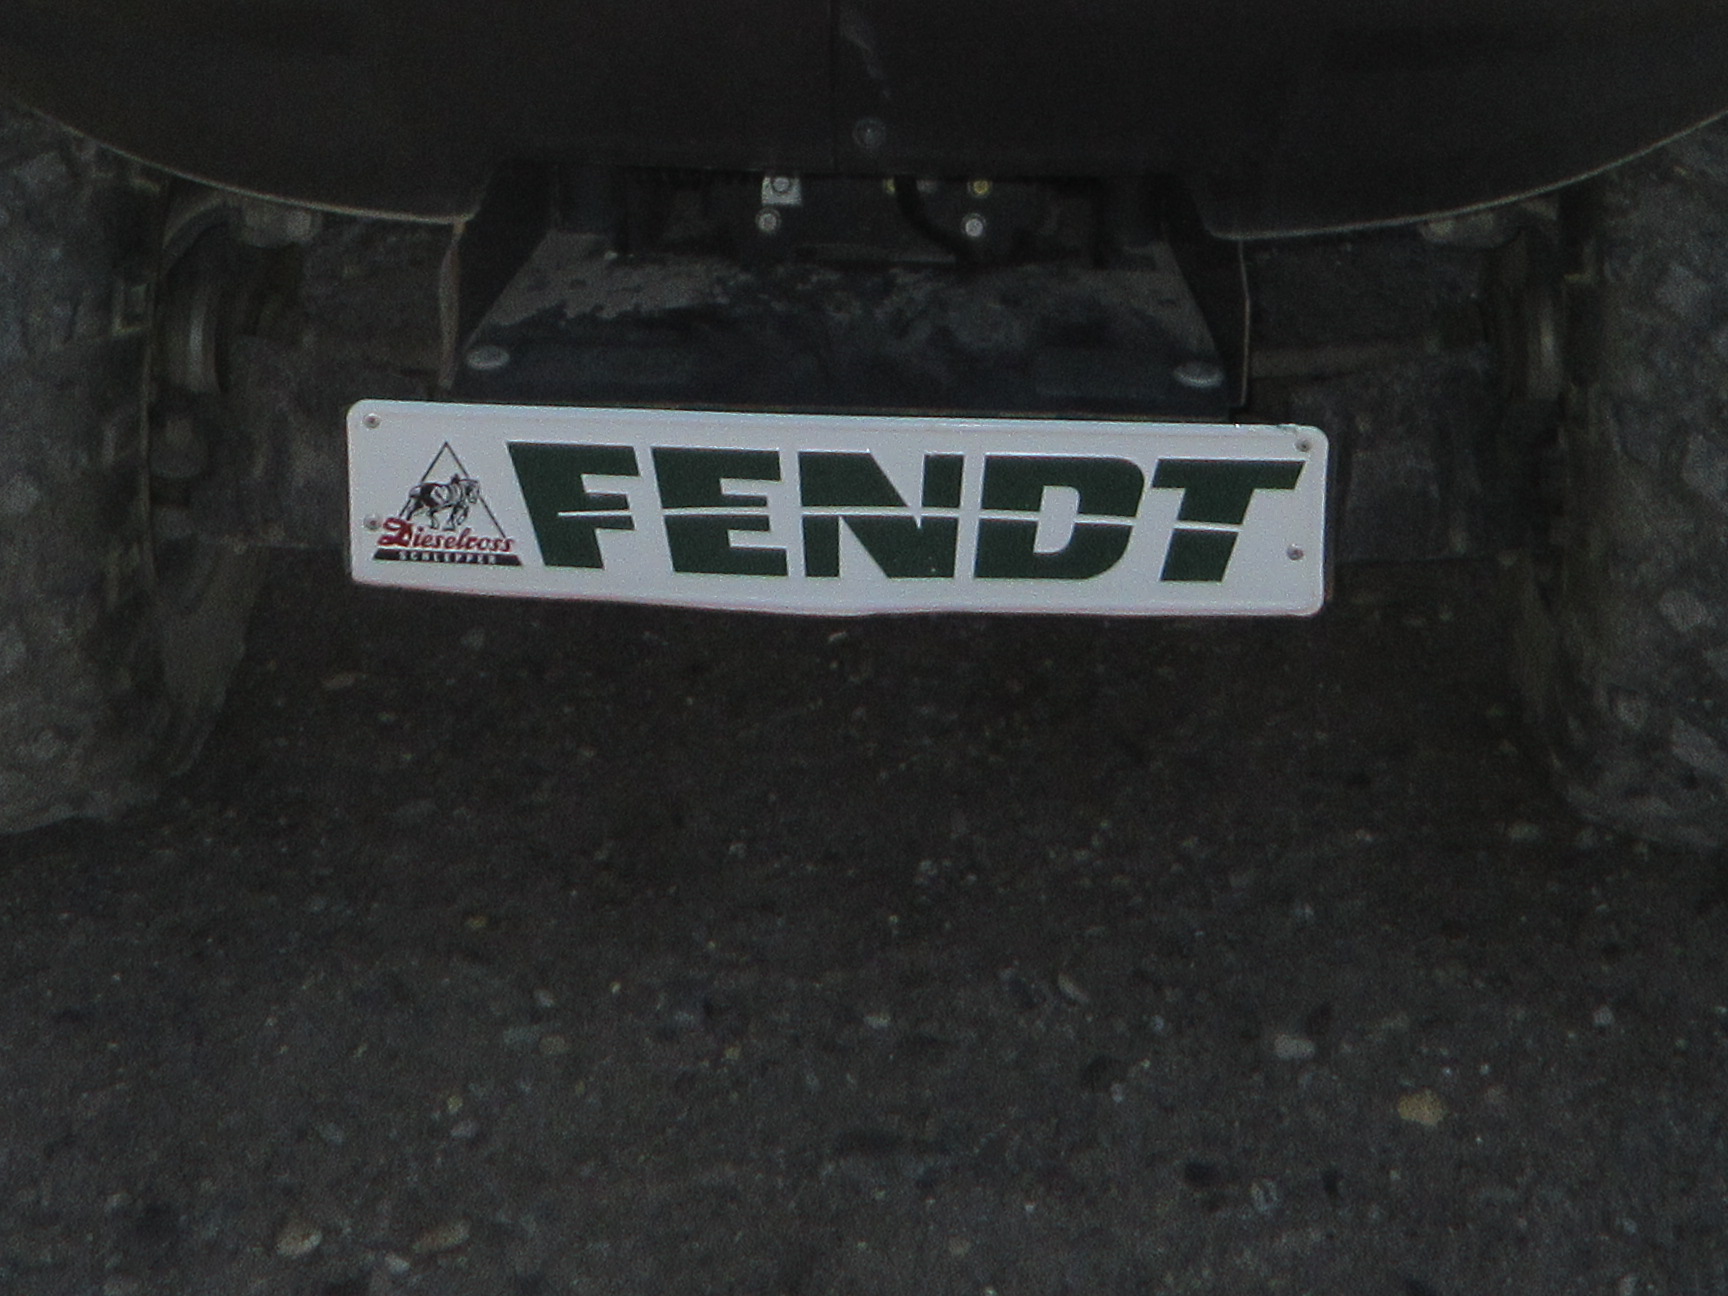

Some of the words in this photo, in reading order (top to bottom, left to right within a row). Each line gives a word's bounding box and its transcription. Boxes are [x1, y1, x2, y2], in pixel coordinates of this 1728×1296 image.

[507, 441, 1306, 583] FENDT
[377, 517, 516, 552] Dieselross
[398, 550, 497, 565] SCHLEPPER
